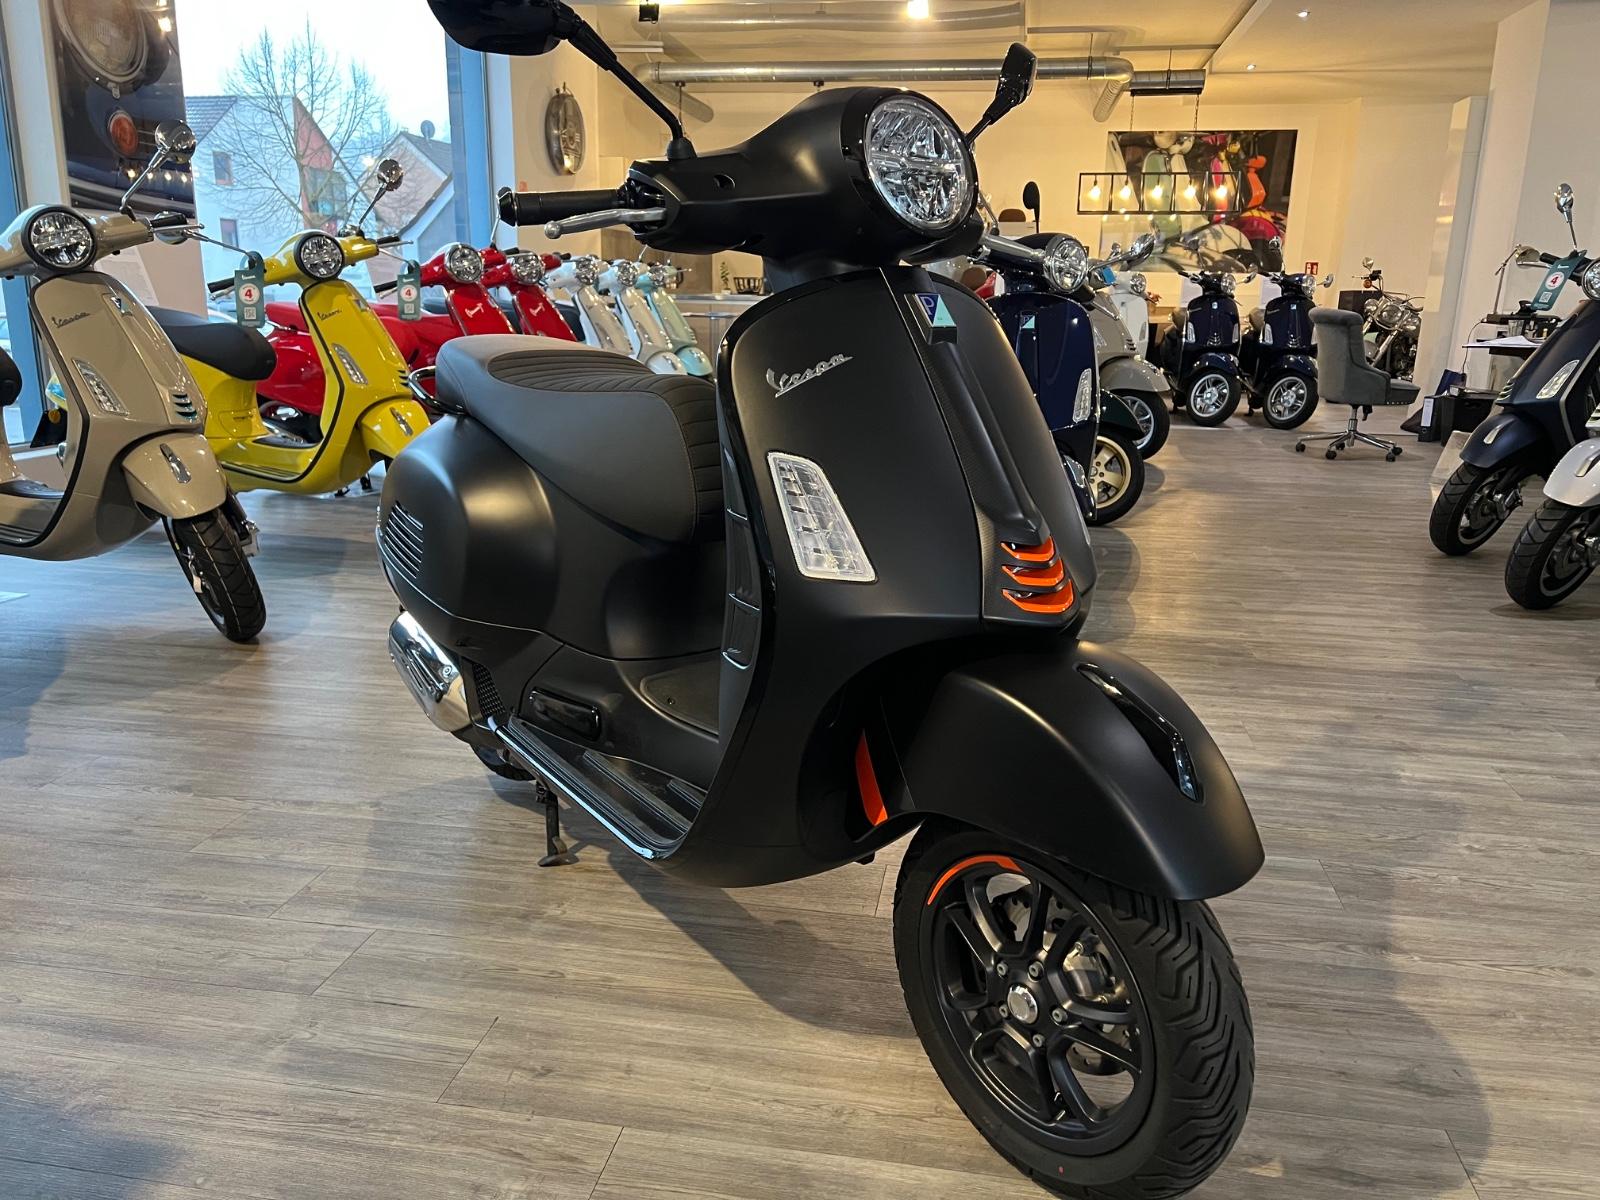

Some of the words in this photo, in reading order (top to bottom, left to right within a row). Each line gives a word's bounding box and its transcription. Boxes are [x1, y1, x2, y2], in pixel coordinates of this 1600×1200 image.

[1550, 276, 1559, 285] 4
[244, 288, 253, 299] 4
[405, 288, 412, 297] 4
[920, 296, 935, 315] P
[765, 353, 854, 398] Vespa
